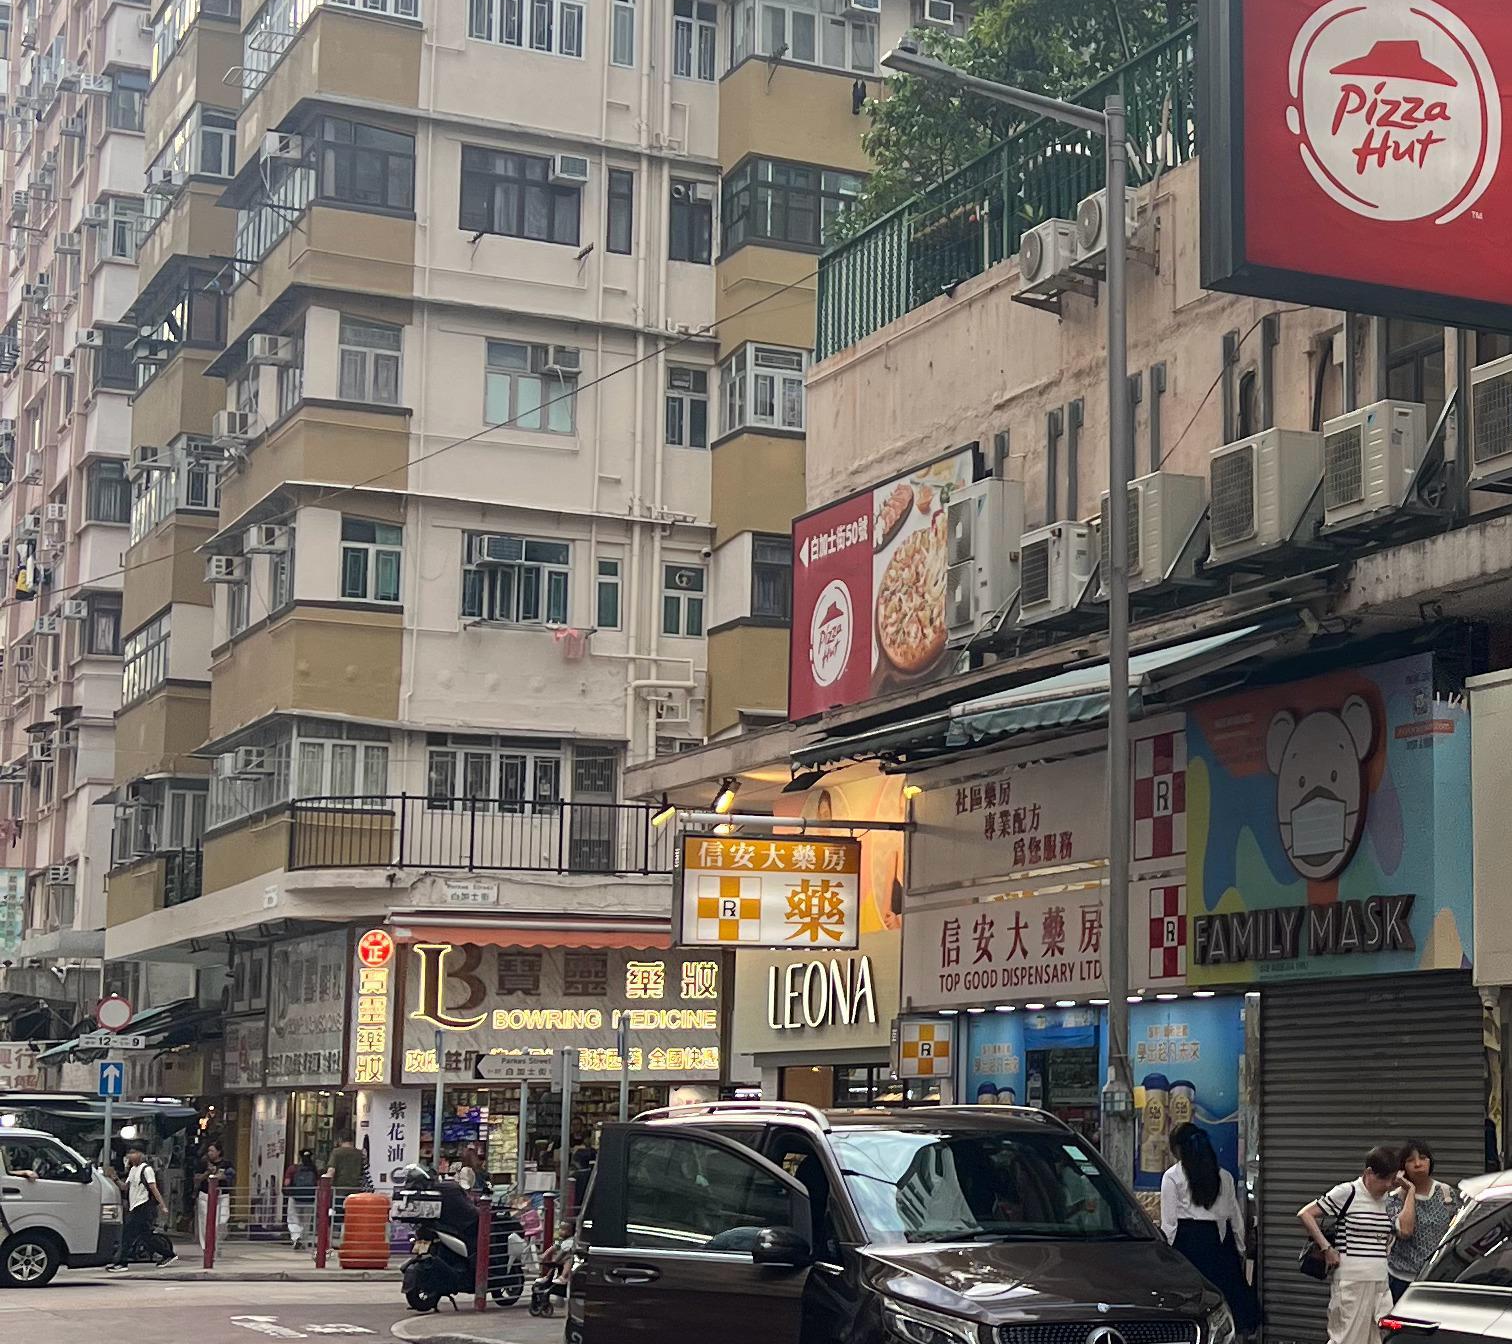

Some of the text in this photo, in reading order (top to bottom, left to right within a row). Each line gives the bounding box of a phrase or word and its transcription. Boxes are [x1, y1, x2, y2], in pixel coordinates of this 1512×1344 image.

[1331, 81, 1451, 136] Pizza
[1352, 127, 1446, 175] Hut
[810, 515, 868, 562] 白加士街50號
[818, 623, 842, 654] Pizza
[821, 641, 840, 669] Hut
[955, 776, 1012, 816] 社區藥房
[984, 803, 1042, 841] 專業配方
[698, 840, 847, 872] 信安大藥房
[784, 879, 845, 943] 藥
[1193, 894, 1416, 965] FAMILY MASK
[940, 900, 1103, 968] 信安大藥房
[768, 955, 876, 1029] LEONA
[939, 973, 960, 993] TOP
[963, 969, 998, 990] GOOD
[1001, 962, 1075, 987] DISPENSARY
[492, 1009, 602, 1030] BOWRING
